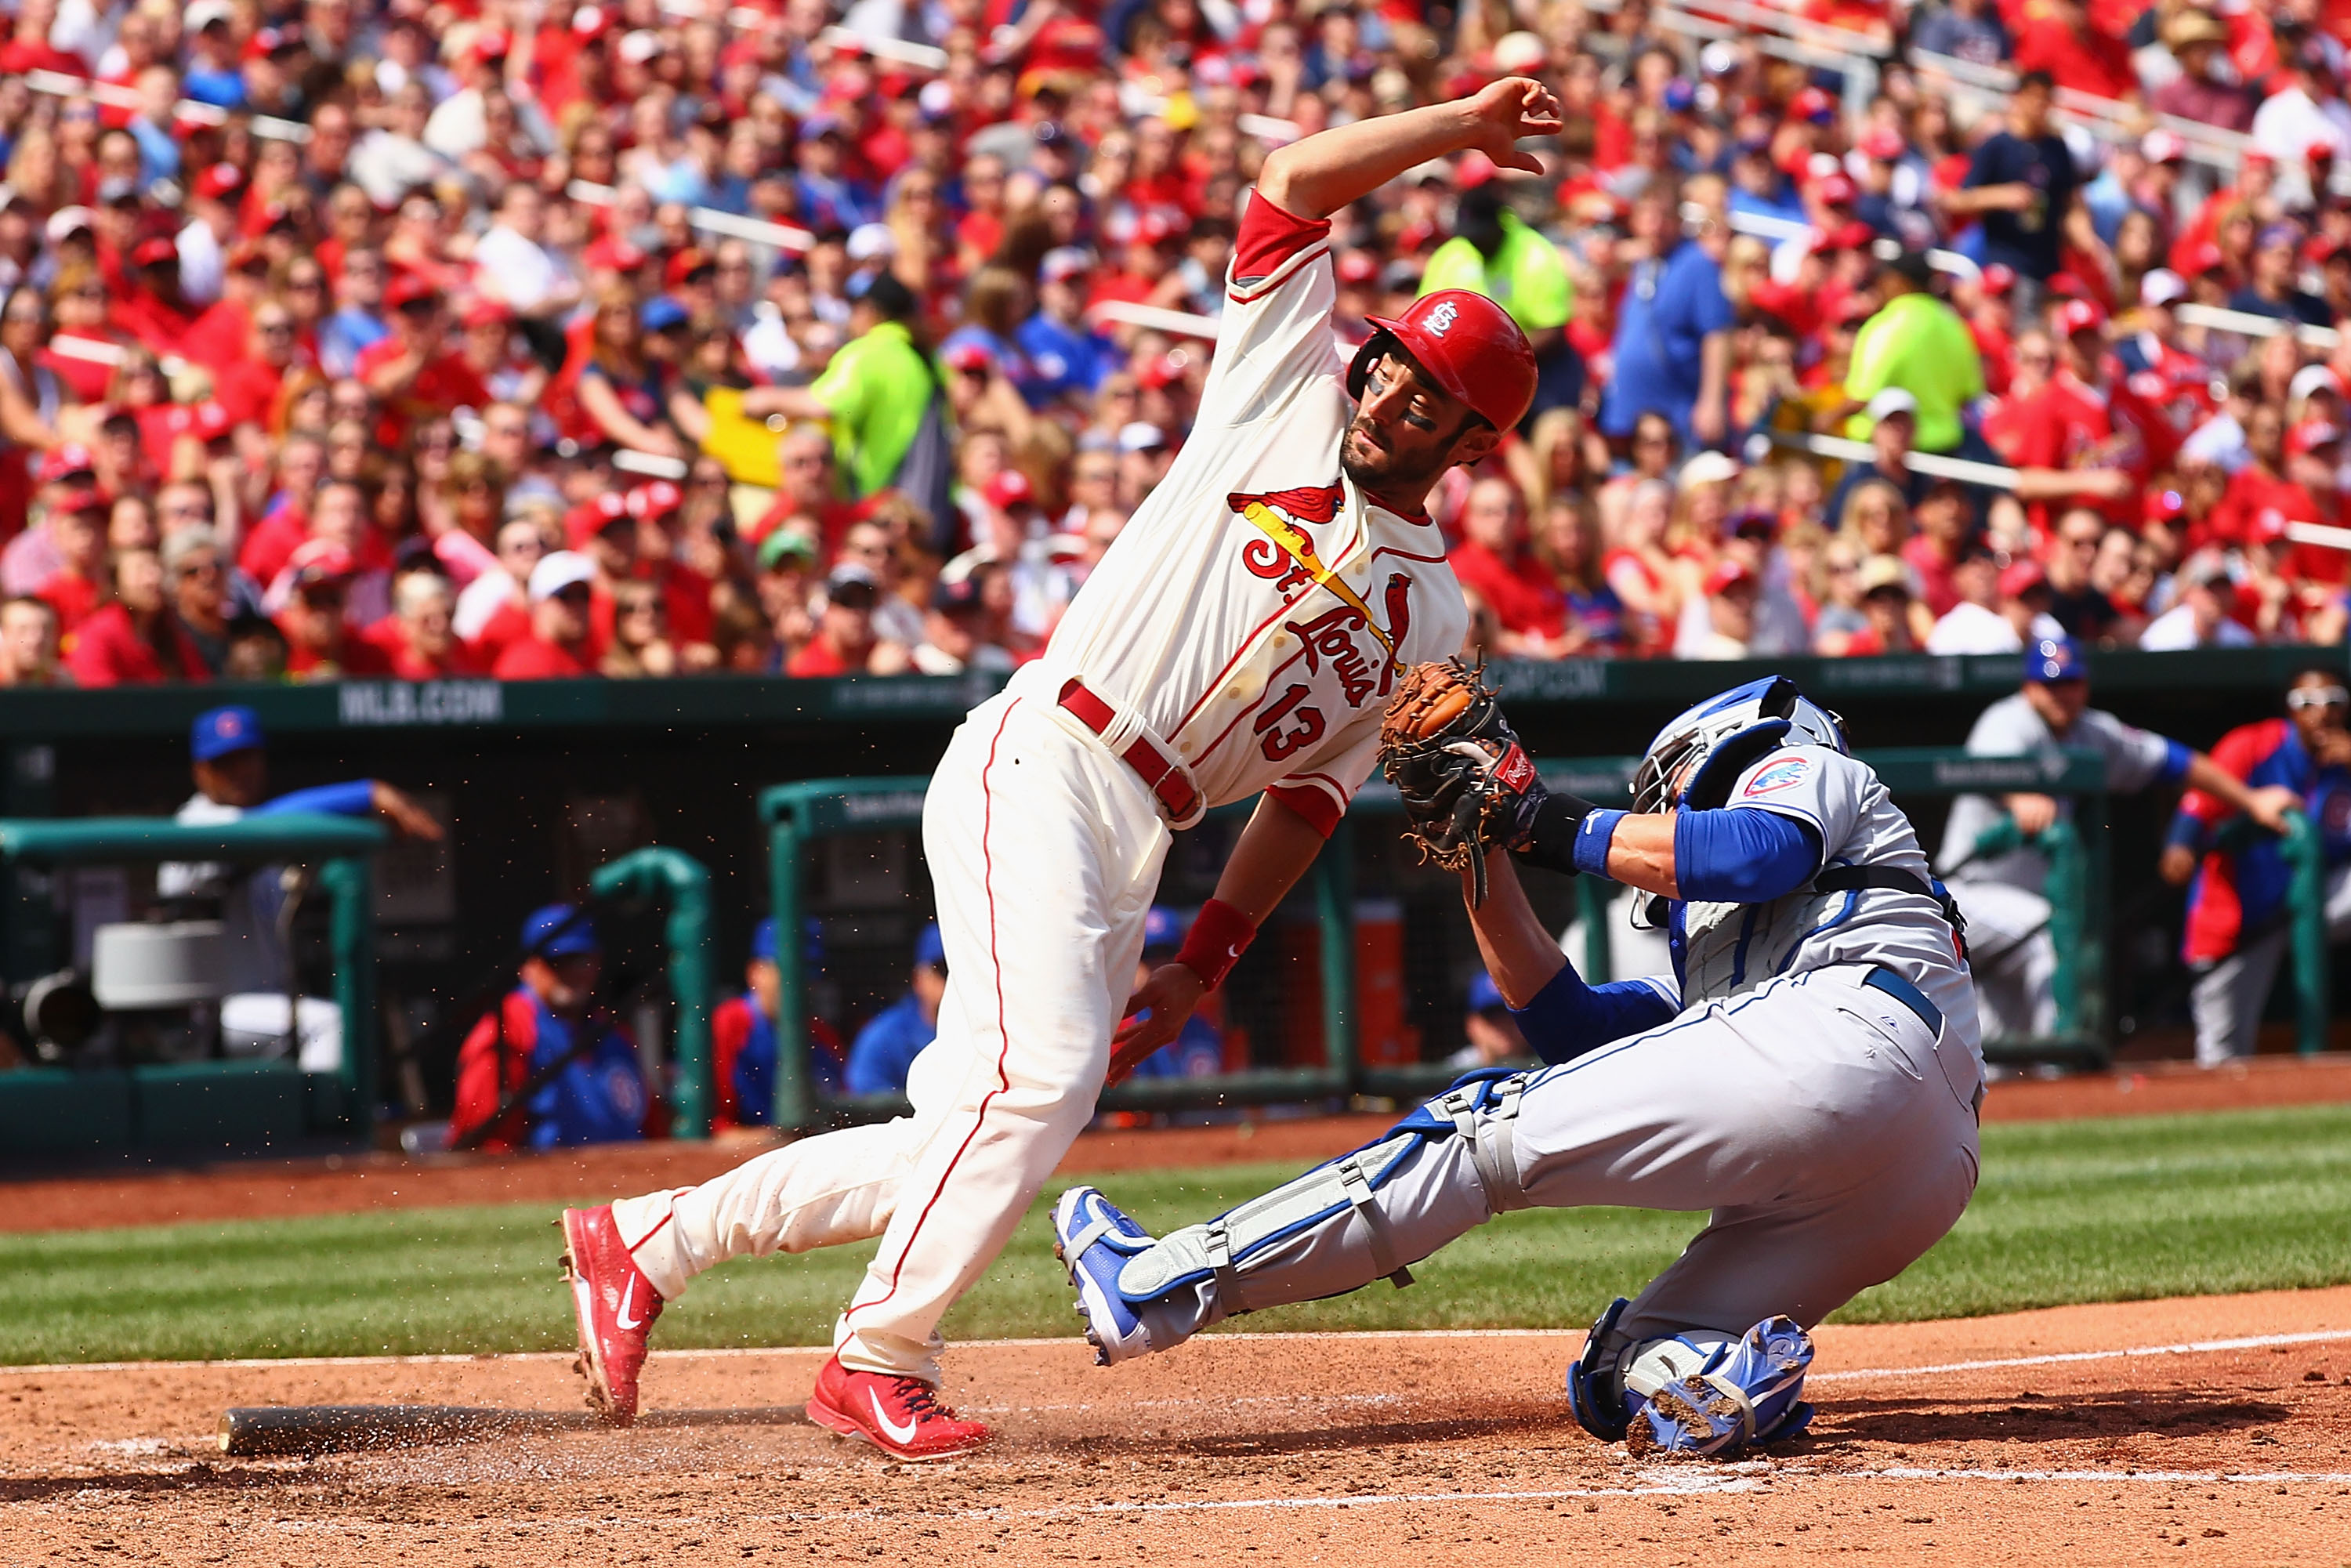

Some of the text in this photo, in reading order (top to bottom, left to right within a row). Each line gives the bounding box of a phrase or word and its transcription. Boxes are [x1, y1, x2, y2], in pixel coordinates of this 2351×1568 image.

[1285, 606, 1380, 708] Louis
[339, 681, 504, 724] MLB.COM
[1254, 683, 1326, 762] 13
